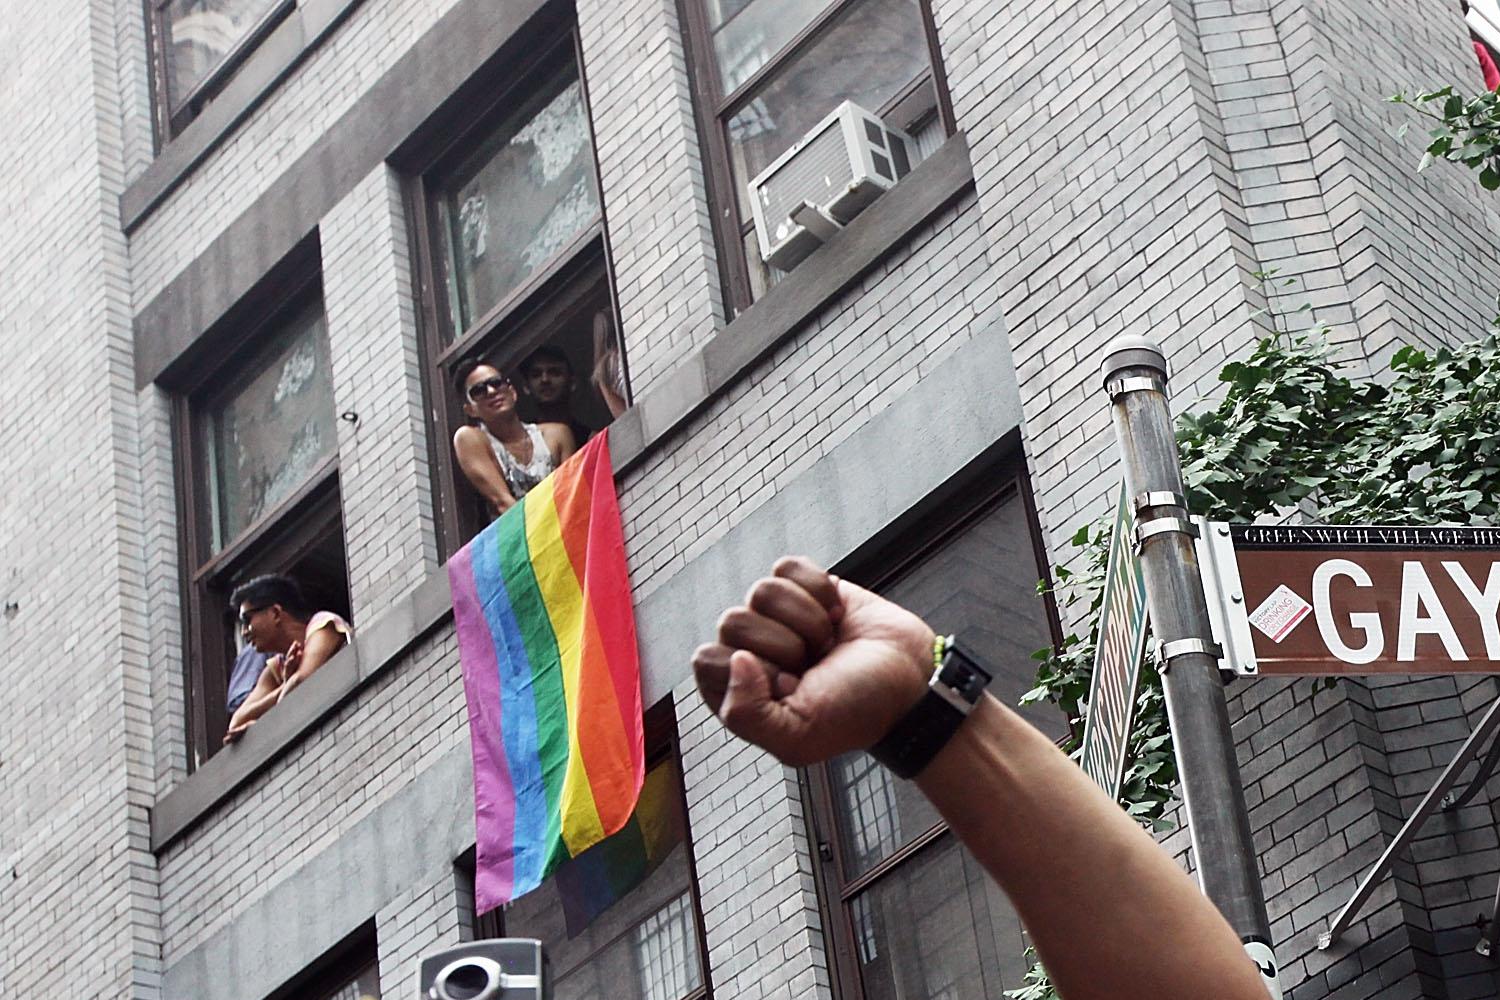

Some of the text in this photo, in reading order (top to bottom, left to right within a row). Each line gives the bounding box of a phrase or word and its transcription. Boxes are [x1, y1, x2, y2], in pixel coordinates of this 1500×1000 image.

[1244, 528, 1370, 544] GREENWICH
[1378, 529, 1465, 545] VILLAGE
[1257, 596, 1293, 630] DRINKING
